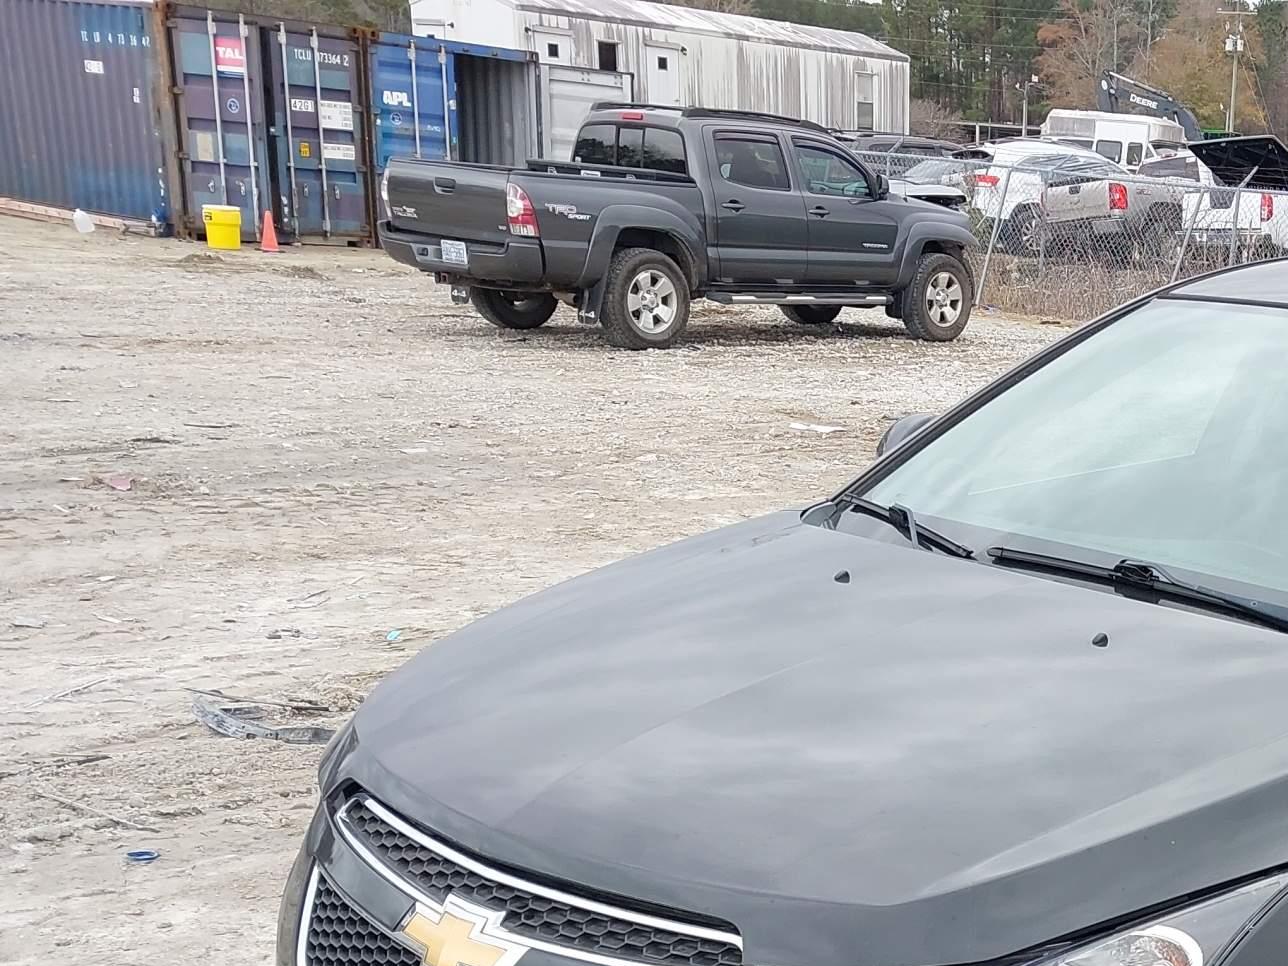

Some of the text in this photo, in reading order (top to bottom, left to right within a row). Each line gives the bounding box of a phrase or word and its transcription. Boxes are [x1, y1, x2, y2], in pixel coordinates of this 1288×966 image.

[215, 46, 244, 60] TAL
[294, 49, 350, 67] TCLU 73364 2
[383, 90, 412, 107] APL
[1129, 93, 1159, 109] DEERE
[544, 202, 577, 216] TRD
